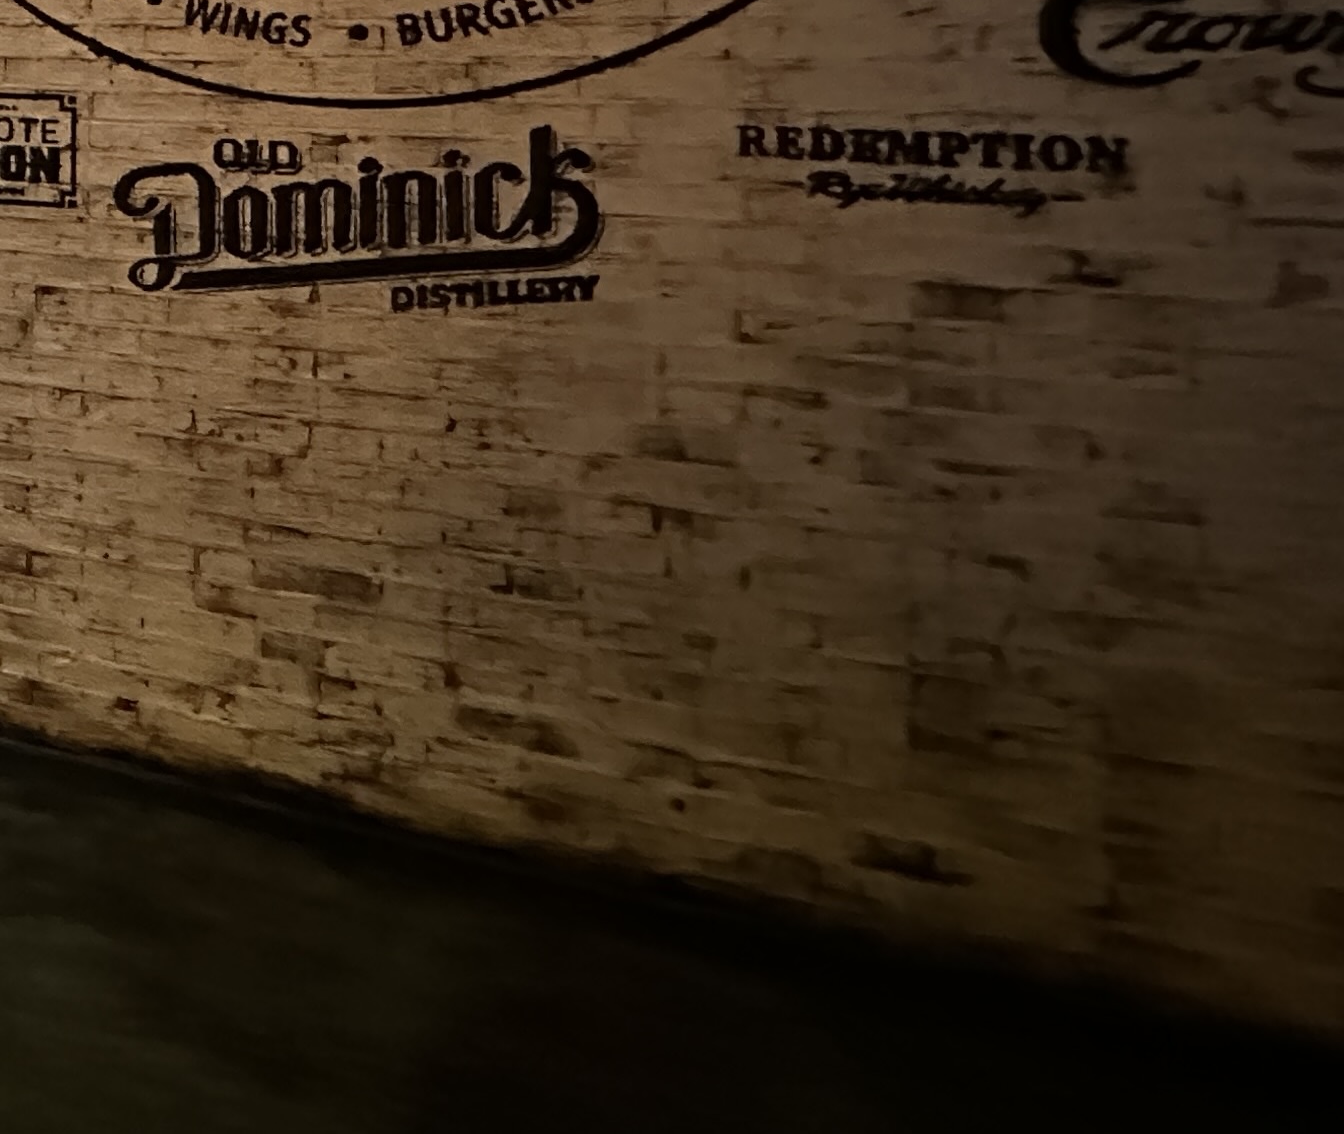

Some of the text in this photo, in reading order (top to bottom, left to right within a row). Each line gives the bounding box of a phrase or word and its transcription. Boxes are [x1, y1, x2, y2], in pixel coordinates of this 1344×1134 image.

[213, 138, 303, 174] OLD
[738, 125, 1130, 173] REDEMPTION
[112, 124, 606, 292] Dominick
[390, 274, 601, 314] DISTILLERY
